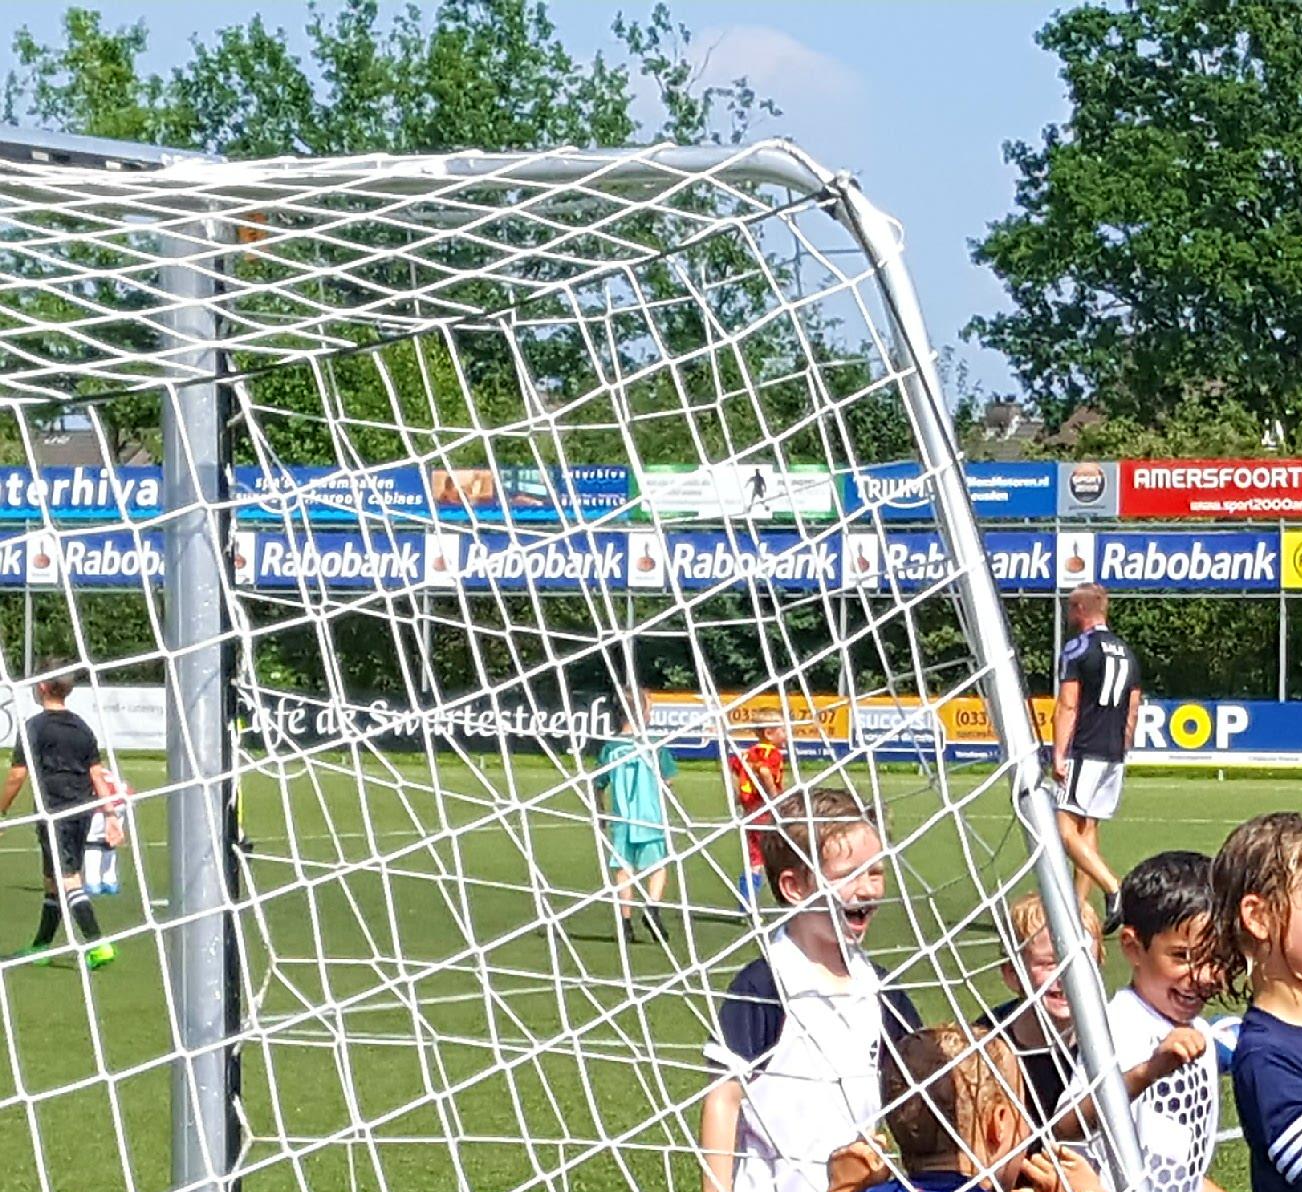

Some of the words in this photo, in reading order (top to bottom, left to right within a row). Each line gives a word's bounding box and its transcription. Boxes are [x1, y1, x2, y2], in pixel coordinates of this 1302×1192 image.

[0, 467, 159, 506] terhiva
[66, 540, 165, 576] Rabob
[260, 541, 420, 579] Rabobank
[466, 541, 623, 579] Rabobank
[673, 541, 838, 579] Rabobank
[884, 541, 1052, 579] Rabank
[1101, 541, 1277, 580] Rabobank
[1098, 655, 1129, 708] 11
